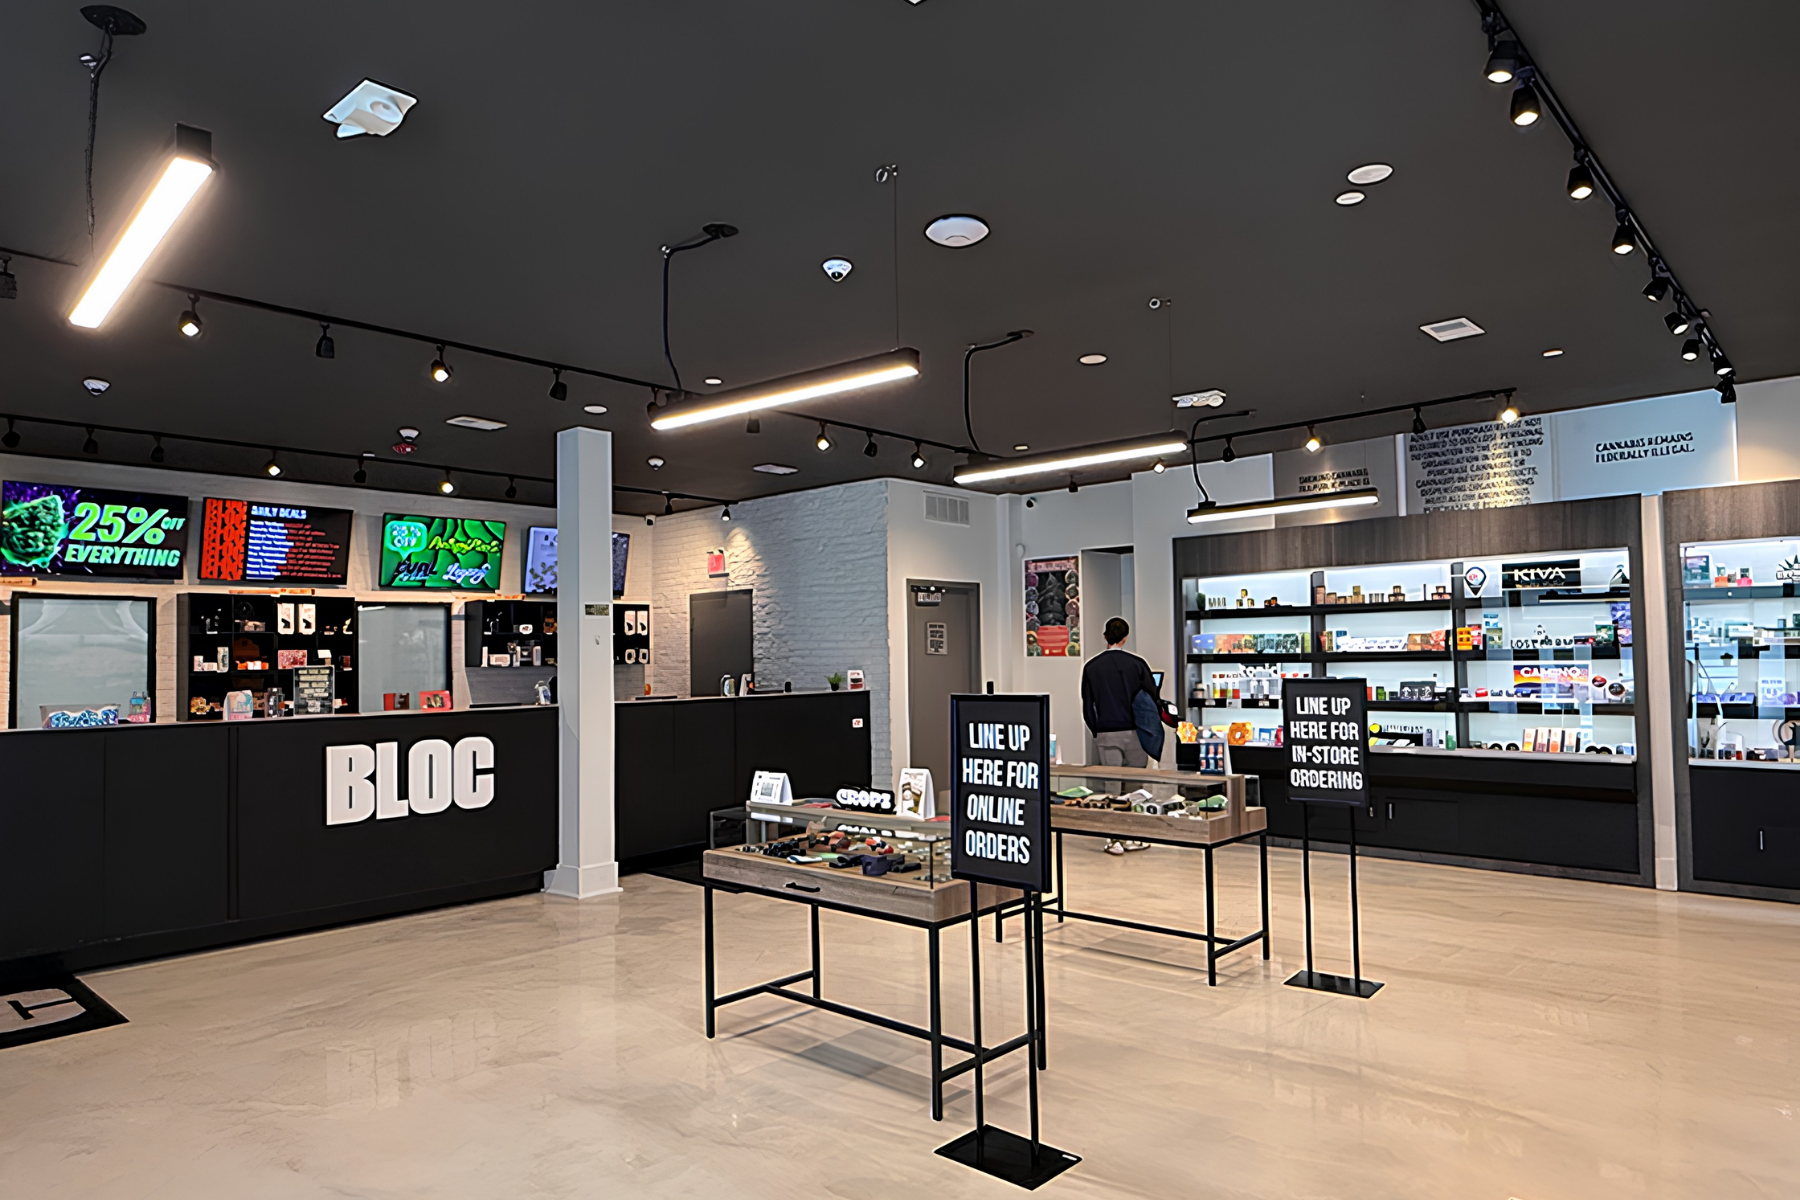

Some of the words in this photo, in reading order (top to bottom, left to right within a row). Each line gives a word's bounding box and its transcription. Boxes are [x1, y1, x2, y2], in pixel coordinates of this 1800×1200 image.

[69, 502, 169, 545] 25%
[64, 543, 181, 567] EVERYTHING
[1513, 566, 1566, 581] KIVA
[1296, 696, 1328, 715] LINE
[1331, 697, 1351, 716] UP
[968, 722, 1004, 749] LINE
[1008, 724, 1031, 751] UP
[1290, 721, 1327, 740] HERE
[1330, 722, 1359, 741] FOR
[1291, 745, 1359, 765] IN-STORE
[326, 736, 494, 825] BLOC
[962, 757, 1003, 787] HERE
[1007, 761, 1039, 790] FOR
[1290, 768, 1363, 790] ORDERING
[966, 793, 1026, 826] ONLINE
[965, 829, 1031, 865] ORDERS
